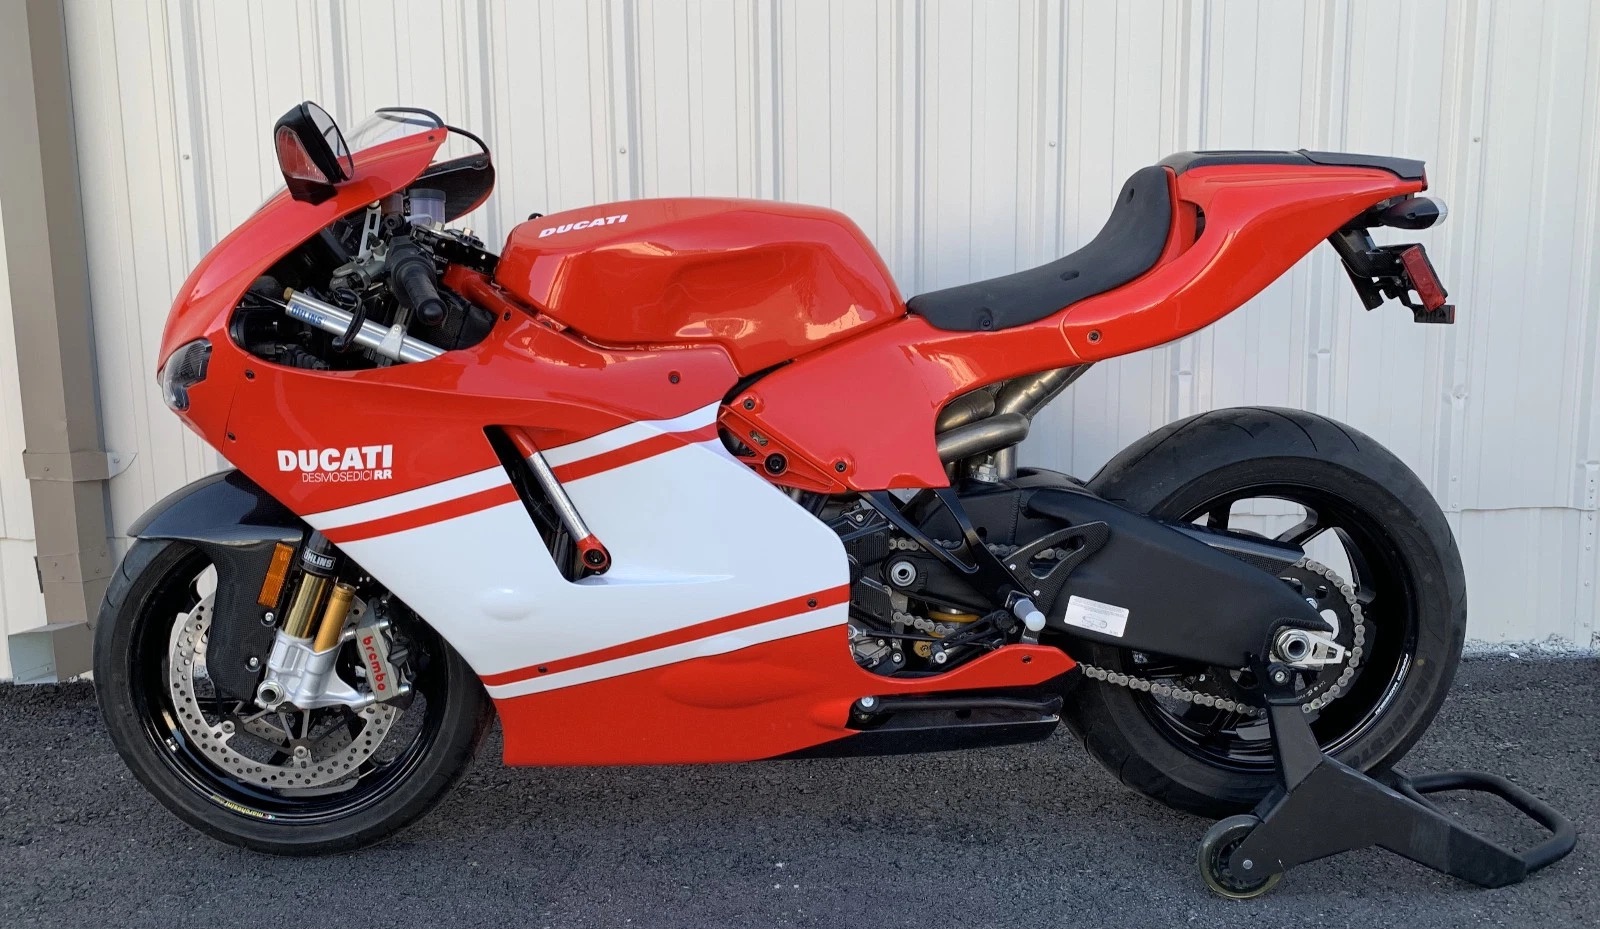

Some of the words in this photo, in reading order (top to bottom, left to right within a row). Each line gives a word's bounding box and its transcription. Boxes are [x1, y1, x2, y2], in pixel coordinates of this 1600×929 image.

[538, 214, 629, 238] DUCATI
[277, 444, 393, 472] DUCATI
[302, 470, 372, 483] DESMOSEDICI
[373, 469, 393, 480] RR
[362, 636, 386, 691] brembo
